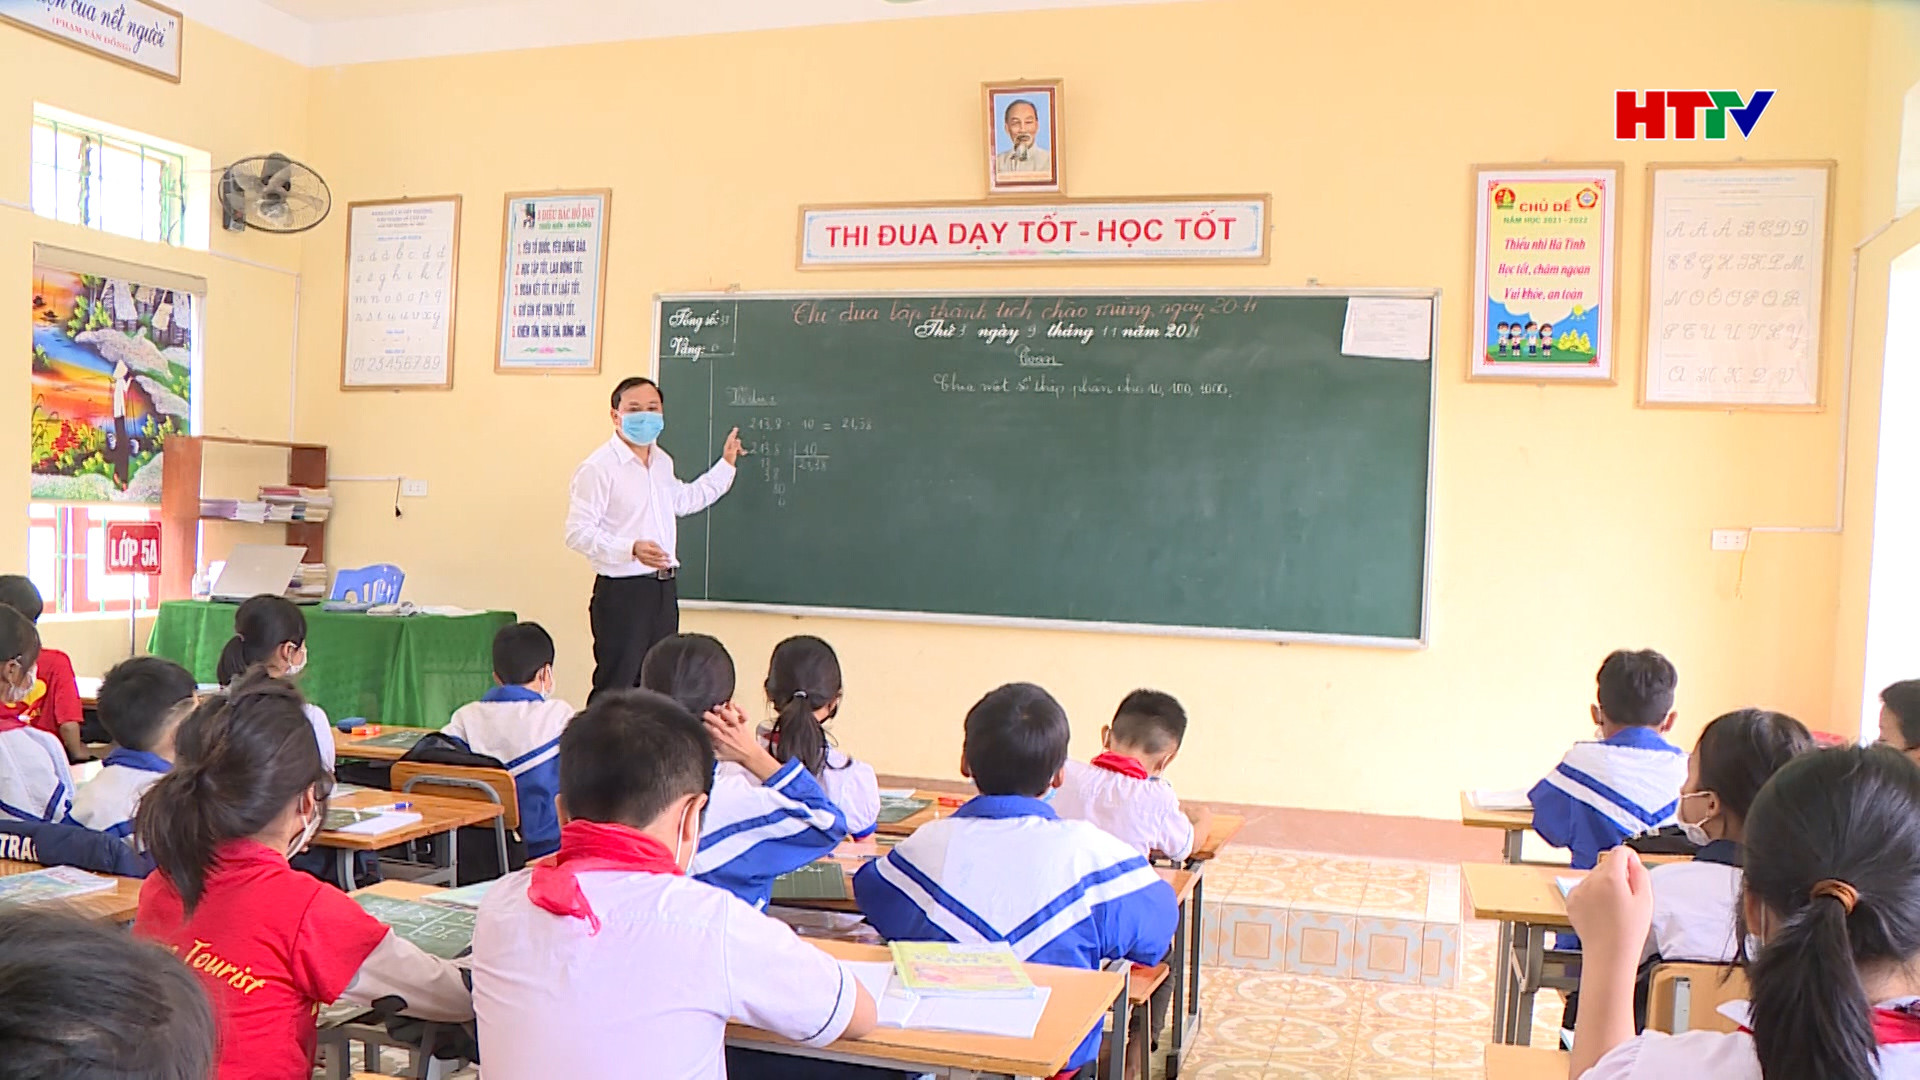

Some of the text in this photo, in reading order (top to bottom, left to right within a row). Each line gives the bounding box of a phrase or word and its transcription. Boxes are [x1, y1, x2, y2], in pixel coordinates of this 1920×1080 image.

[101, 3, 125, 31] nết
[825, 224, 869, 249] THI
[876, 222, 939, 248] ĐUA
[947, 220, 1010, 251] DẠY
[1097, 219, 1164, 249] HỌC
[1173, 208, 1238, 240] TỐT
[977, 323, 1020, 345] ngày
[1047, 321, 1094, 345] tháng
[1121, 324, 1160, 338] năm
[111, 530, 159, 567] LỚP 5A
[184, 938, 267, 995] Tourist
